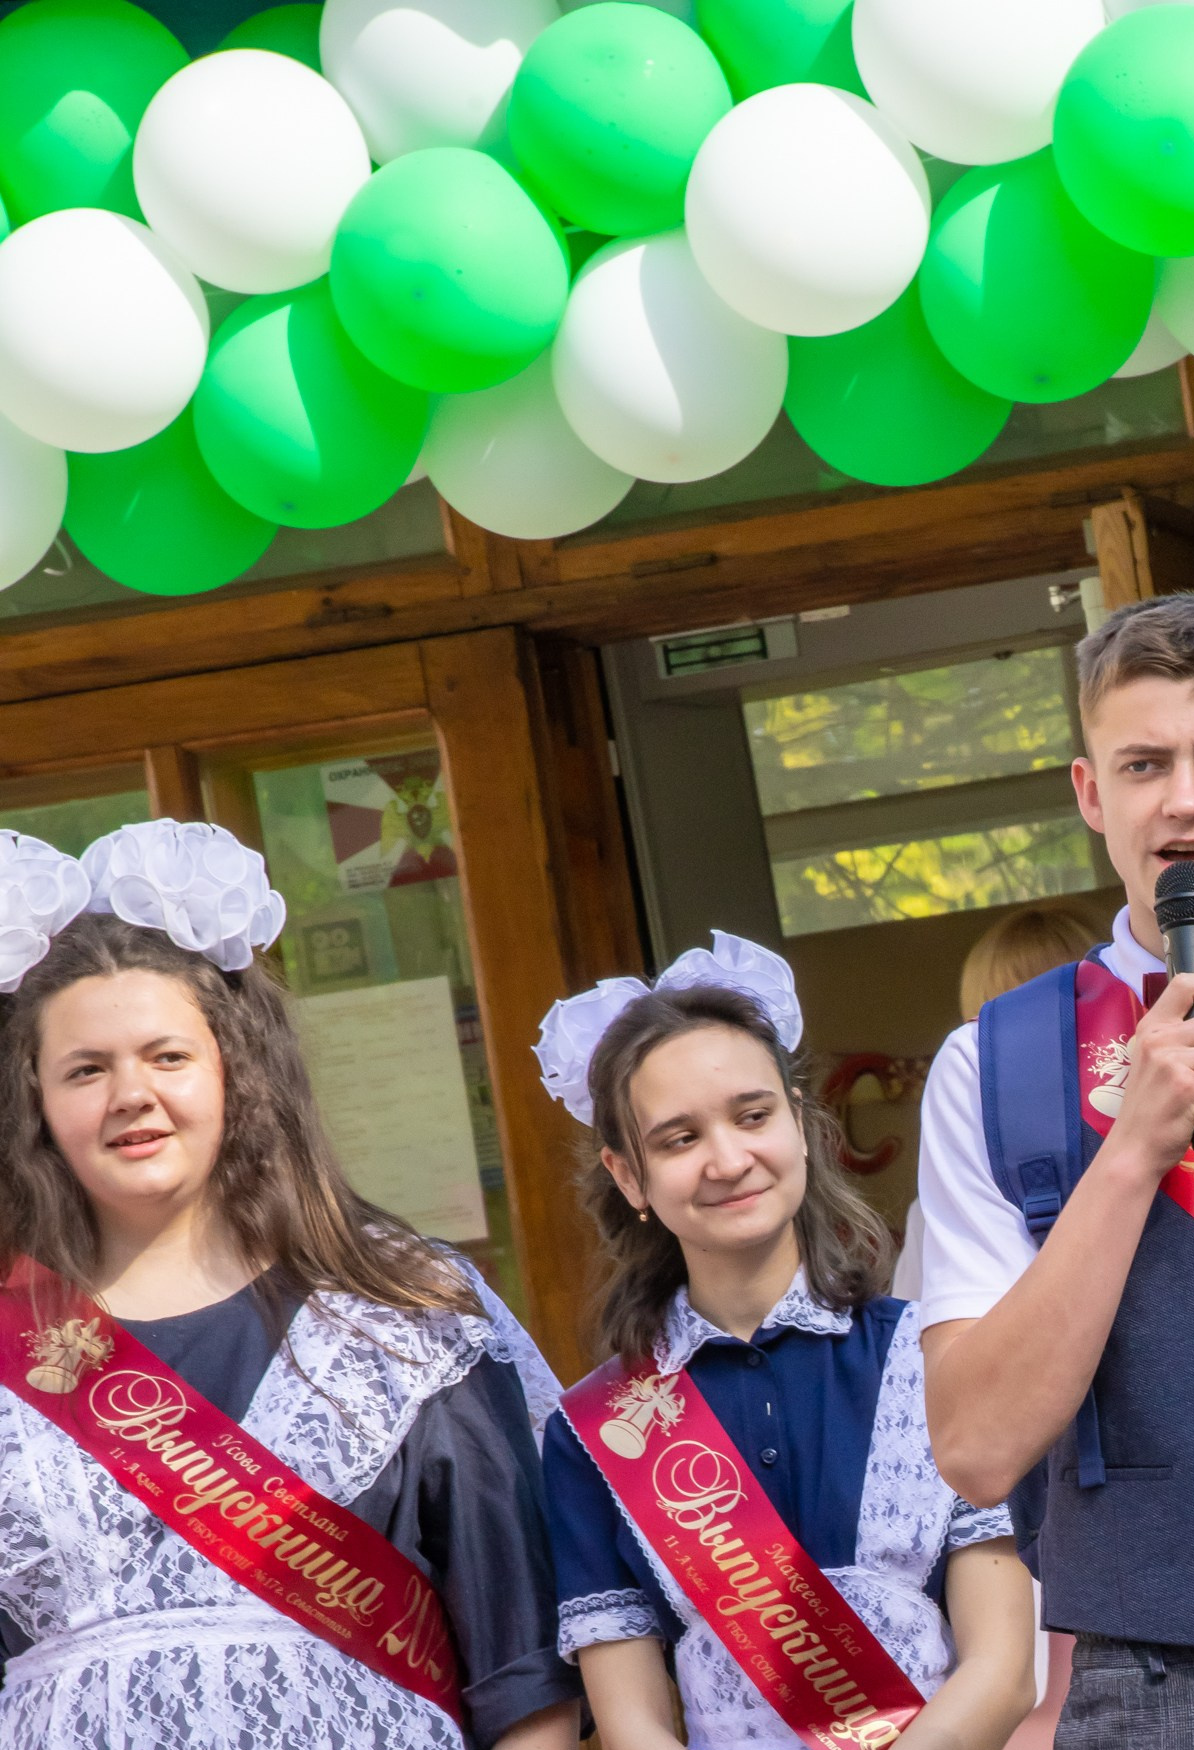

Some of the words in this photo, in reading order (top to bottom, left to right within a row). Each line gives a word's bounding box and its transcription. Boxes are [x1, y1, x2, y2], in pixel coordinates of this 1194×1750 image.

[89, 1370, 386, 1627] Выпускница
[136, 1470, 165, 1497] класс
[212, 1433, 262, 1476] Усова
[262, 1476, 350, 1542] Светлана
[219, 1545, 255, 1570] СОШ
[686, 1566, 710, 1593] класс
[764, 1543, 830, 1618] Макеева
[822, 1622, 863, 1658] Яна
[750, 1653, 782, 1683] СОШ
